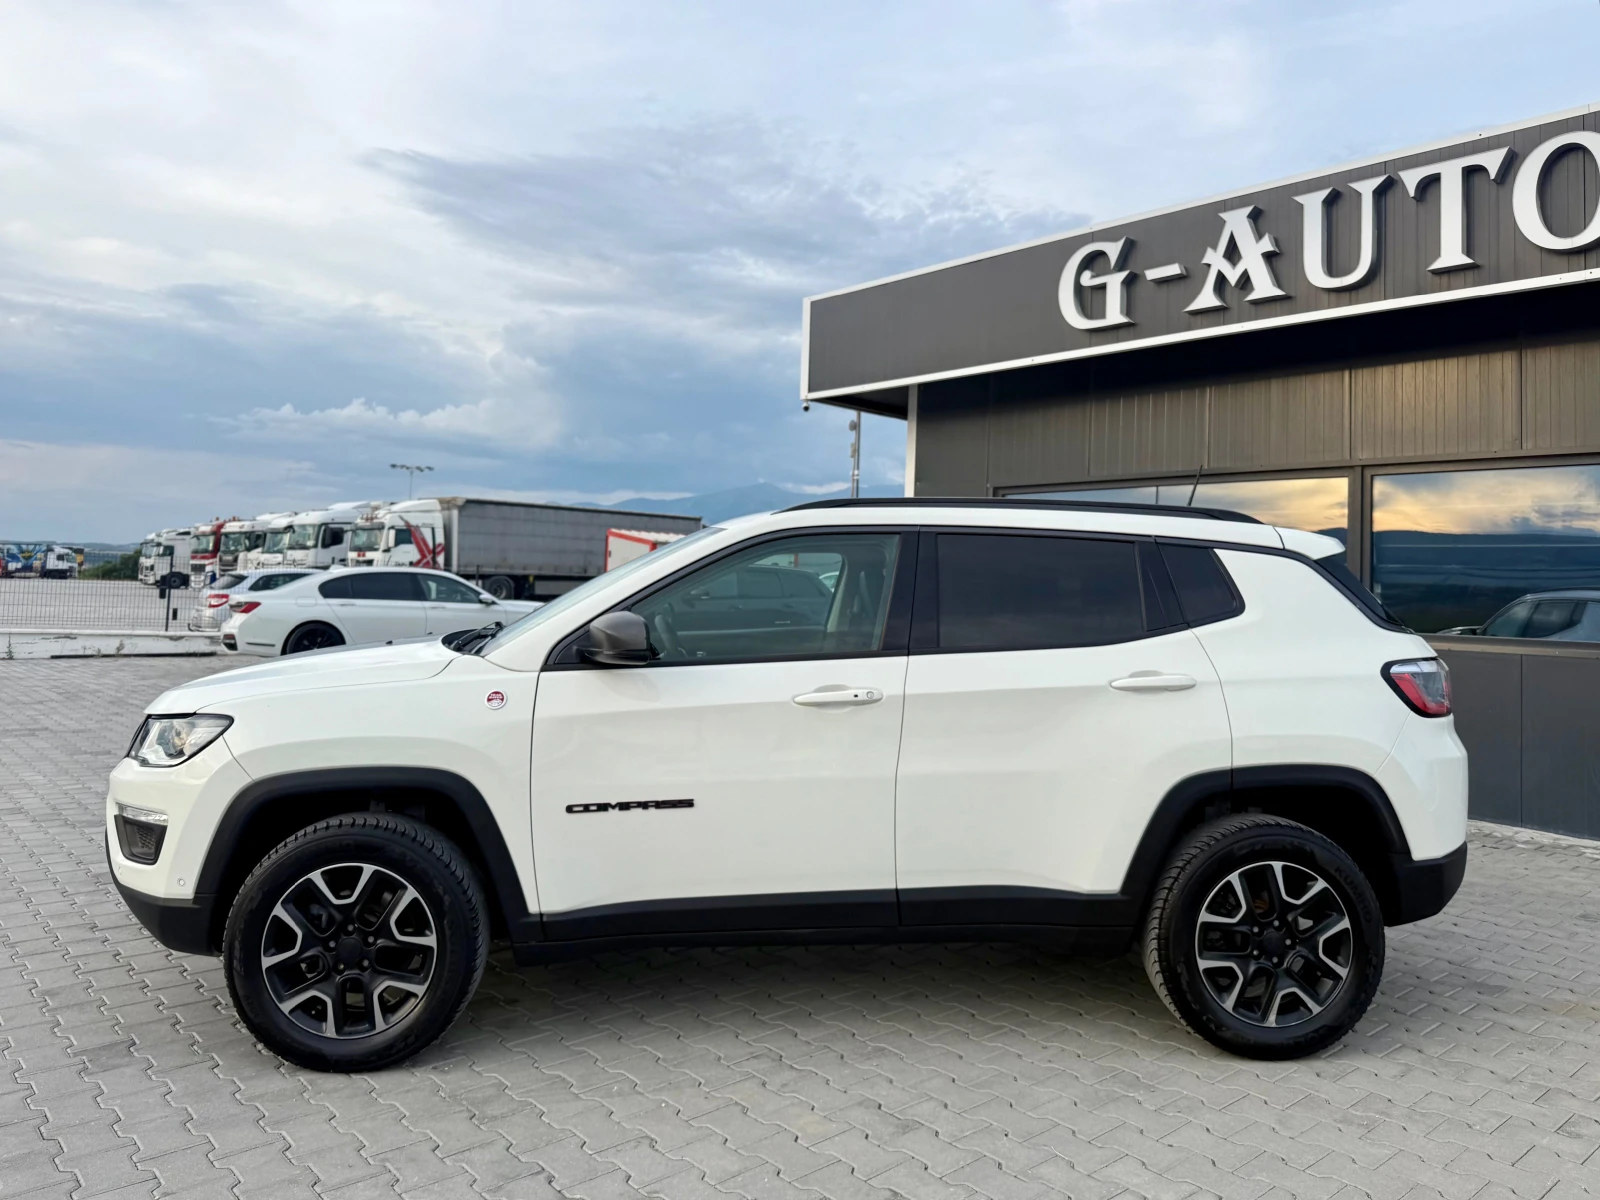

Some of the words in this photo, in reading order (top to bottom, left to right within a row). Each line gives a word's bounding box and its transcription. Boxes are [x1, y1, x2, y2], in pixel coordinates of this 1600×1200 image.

[1058, 130, 1600, 331] G-AUTO
[565, 799, 695, 814] COMPASS
[1334, 866, 1373, 923] KUMHO
